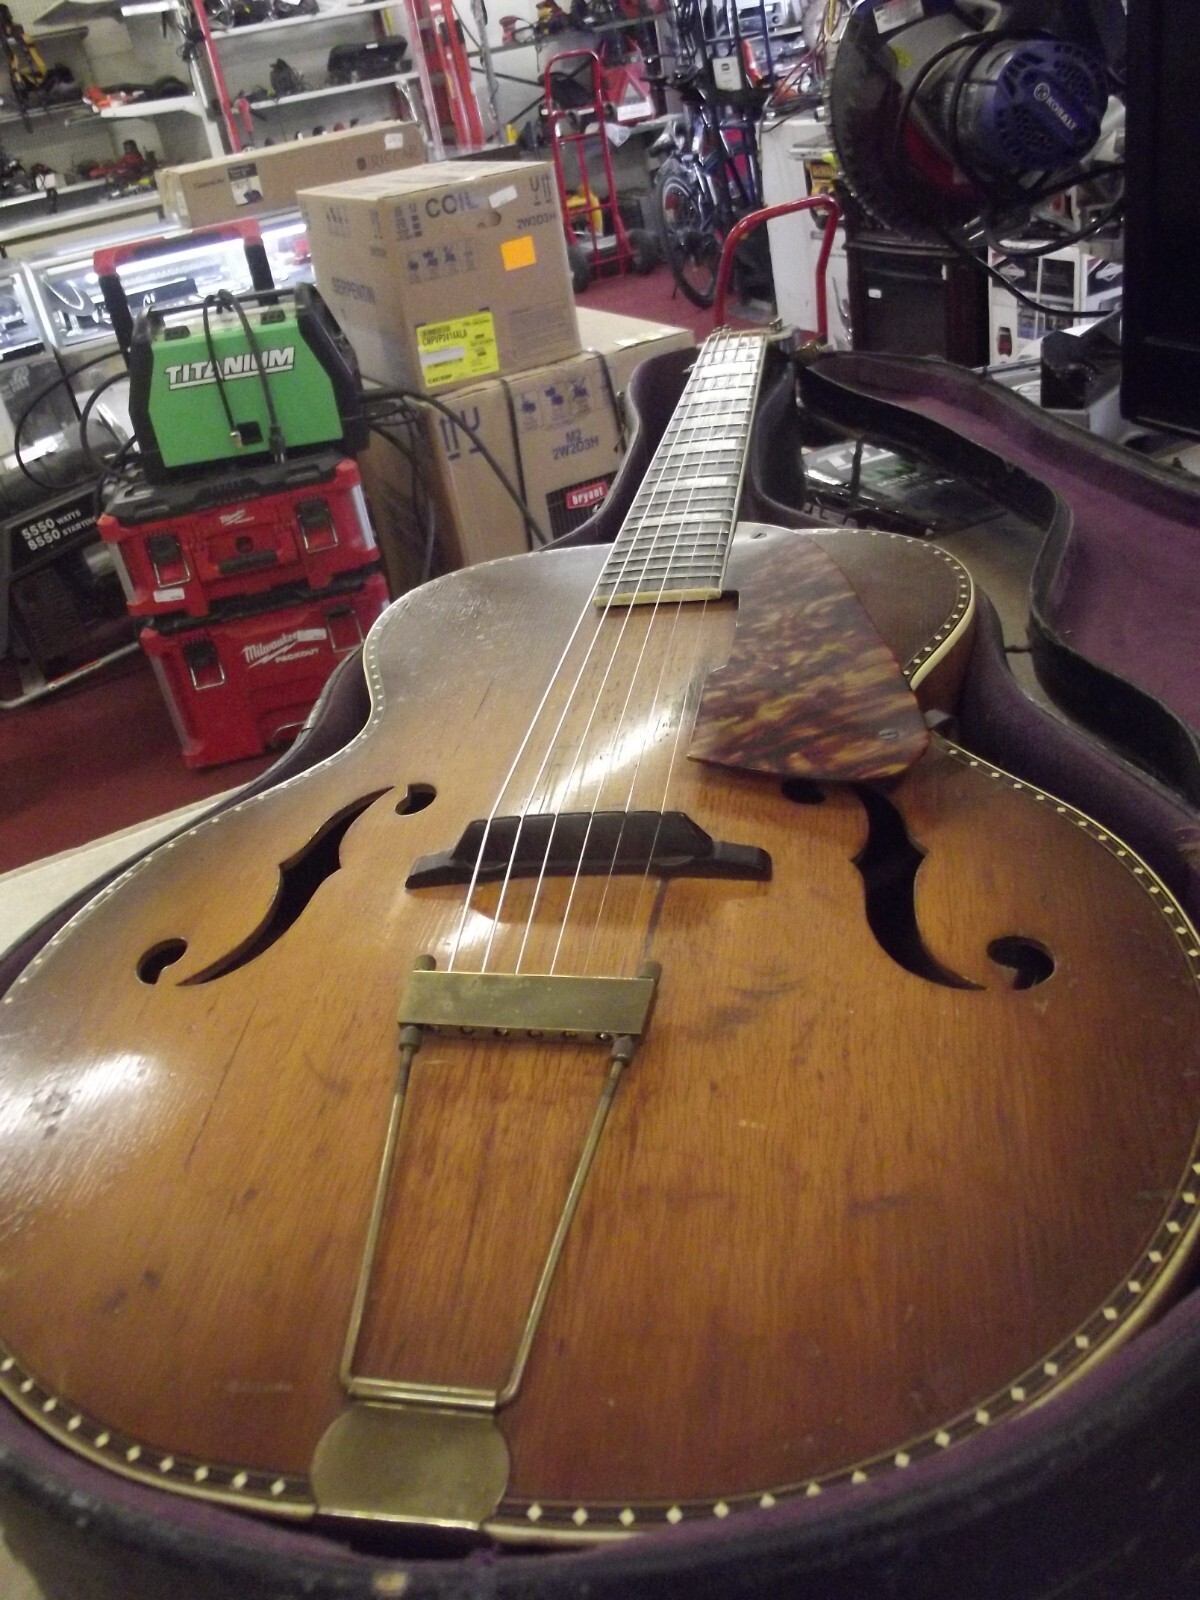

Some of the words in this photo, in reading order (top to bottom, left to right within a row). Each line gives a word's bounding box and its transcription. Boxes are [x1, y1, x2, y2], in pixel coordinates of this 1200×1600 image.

[425, 191, 477, 218] COIL
[165, 346, 295, 385] TITANIUM
[572, 486, 603, 505] bryant
[21, 518, 55, 540] 5550
[55, 510, 81, 524] WATTS
[27, 529, 61, 551] 8550
